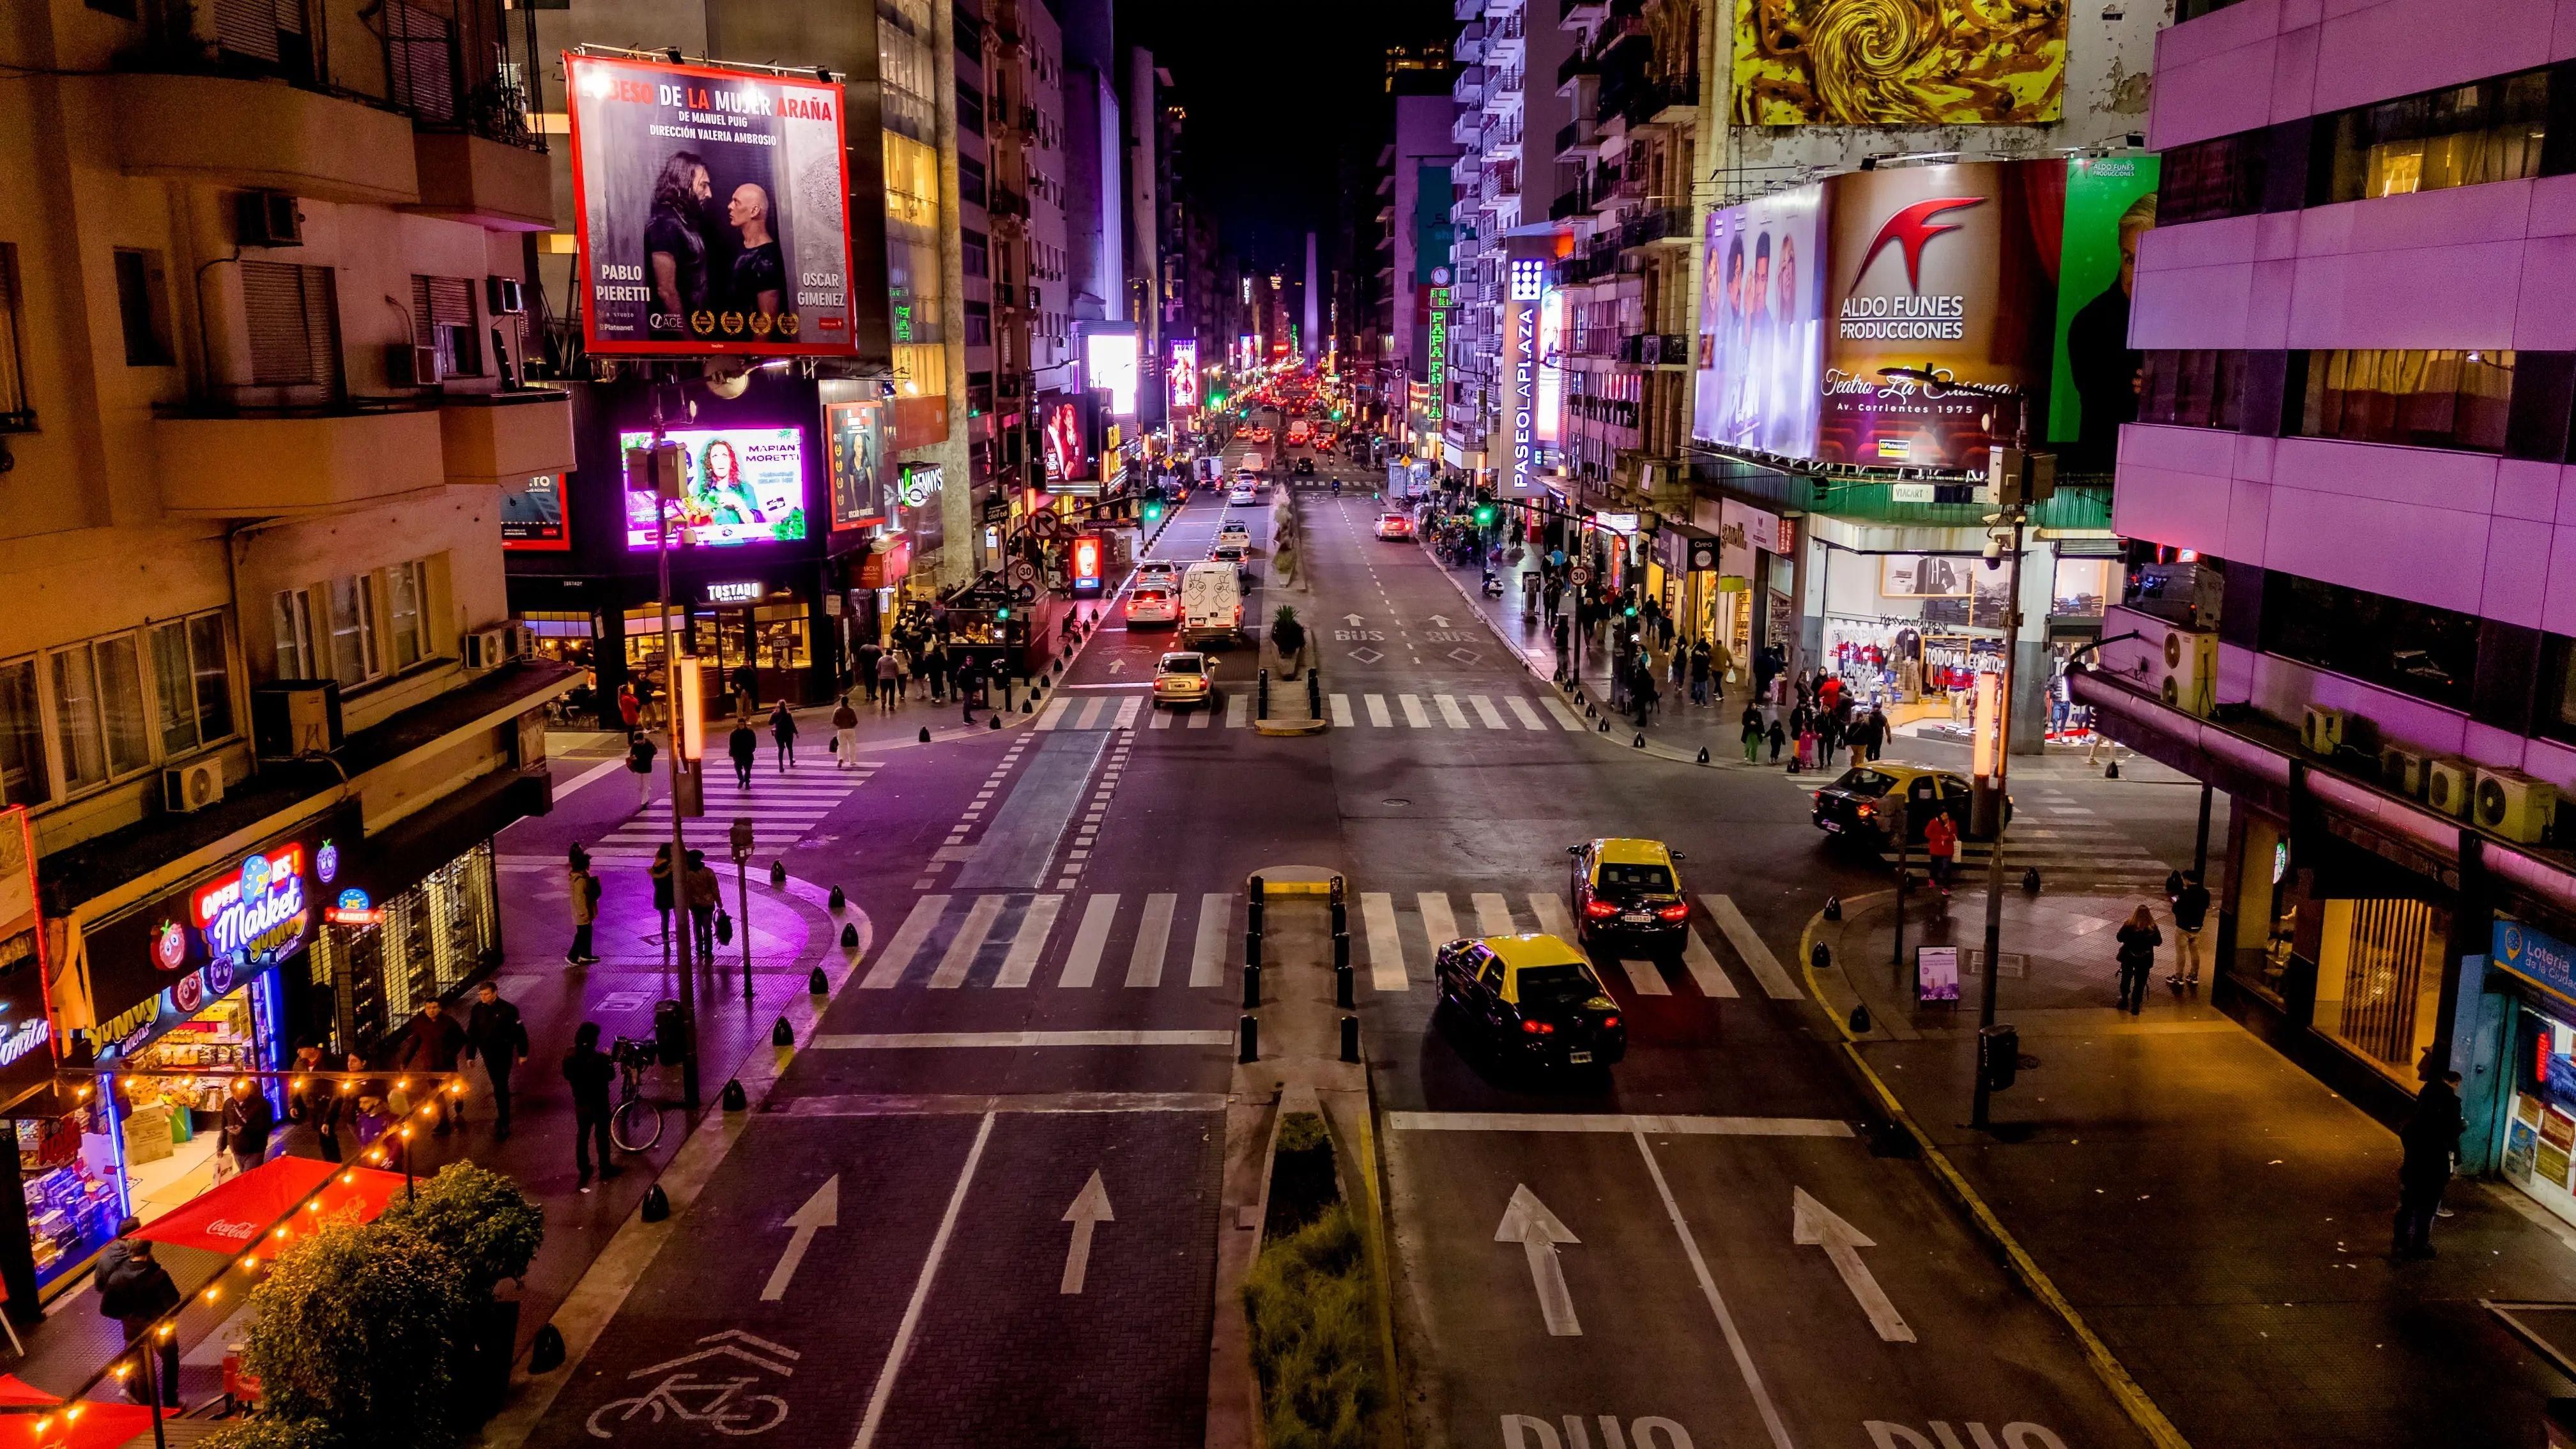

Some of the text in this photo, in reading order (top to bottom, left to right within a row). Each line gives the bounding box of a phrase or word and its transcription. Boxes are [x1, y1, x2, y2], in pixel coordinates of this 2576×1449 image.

[659, 84, 682, 108] DE
[687, 88, 710, 111] LA
[776, 96, 832, 121] ARAÑA
[678, 111, 747, 128] DE MANUEL PUIG
[649, 123, 777, 146] DIRECCIÓN VALERIA AMBROSIO
[601, 264, 642, 281] PABLO
[802, 272, 839, 288] OSCAR
[595, 285, 651, 302] PIERETTI
[797, 291, 845, 307] GIMENEZ
[1840, 295, 1963, 318] ALDO FUNES
[1430, 312, 1445, 358] PAPA
[1840, 321, 1963, 339] PRODUCCIONES
[1821, 367, 1874, 396] Teatro
[1858, 403, 1929, 414] Corrientes
[1937, 405, 1973, 414] 1975
[746, 454, 799, 462] MORETTI
[1020, 567, 1031, 576] 30
[707, 583, 758, 601] TOSTADO
[1334, 629, 1386, 641] BUS
[1924, 647, 1952, 667] TODO
[213, 876, 302, 953] Market
[2525, 958, 2536, 970] de
[2527, 940, 2570, 973] Lotería
[206, 1219, 258, 1240] Coca-Cola
